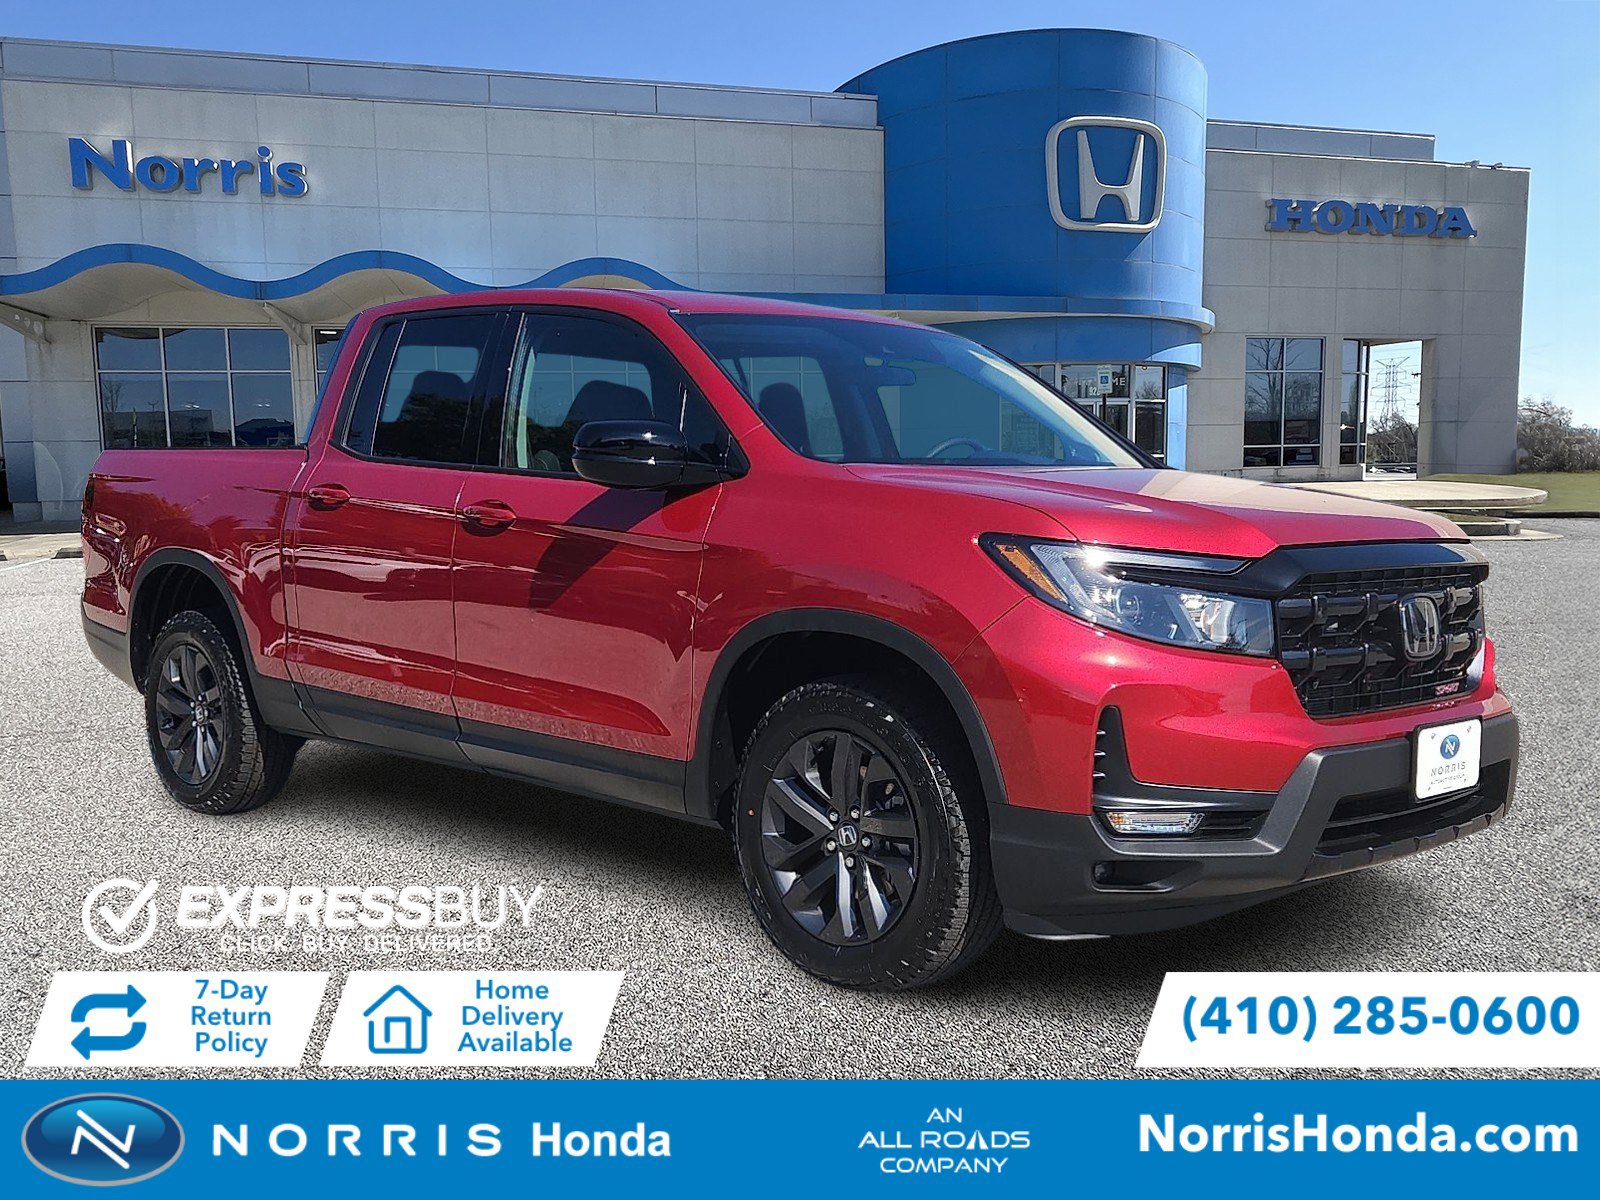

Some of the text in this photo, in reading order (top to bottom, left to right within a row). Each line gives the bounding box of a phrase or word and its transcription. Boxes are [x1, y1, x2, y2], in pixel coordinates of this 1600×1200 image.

[68, 137, 309, 198] Norris
[1265, 198, 1478, 239] HONDA
[1430, 761, 1466, 776] NORRIS
